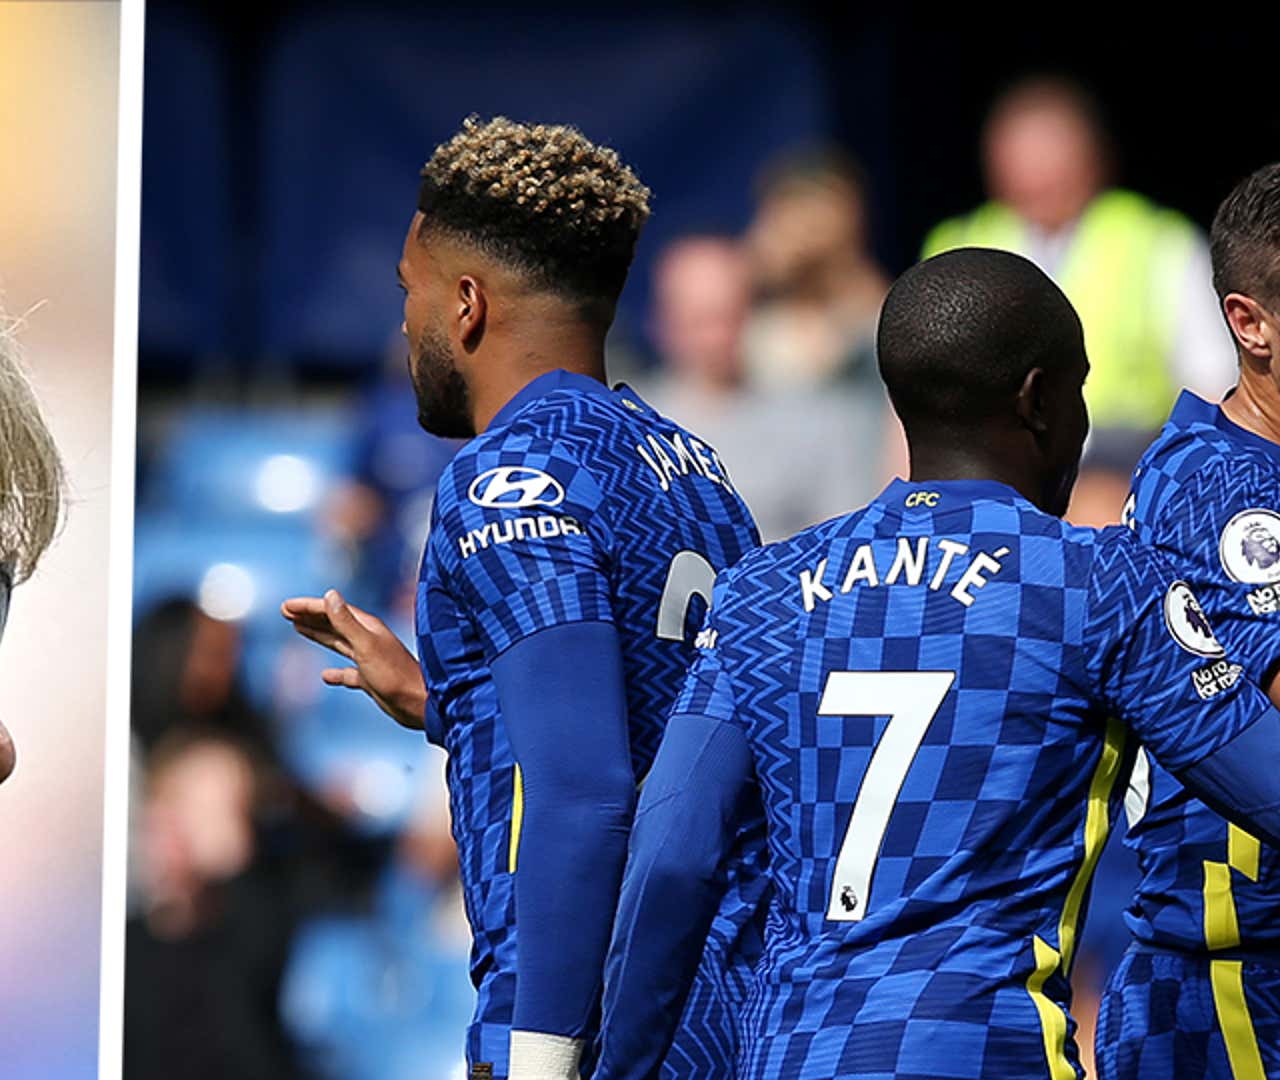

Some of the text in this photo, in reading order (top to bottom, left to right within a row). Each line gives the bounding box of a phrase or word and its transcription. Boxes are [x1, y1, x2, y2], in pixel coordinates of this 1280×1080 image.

[904, 491, 941, 509] CFC
[458, 515, 588, 560] HYUNDA
[799, 536, 1011, 613] KANTÉ
[1246, 587, 1275, 609] No
[816, 670, 957, 922] 7
